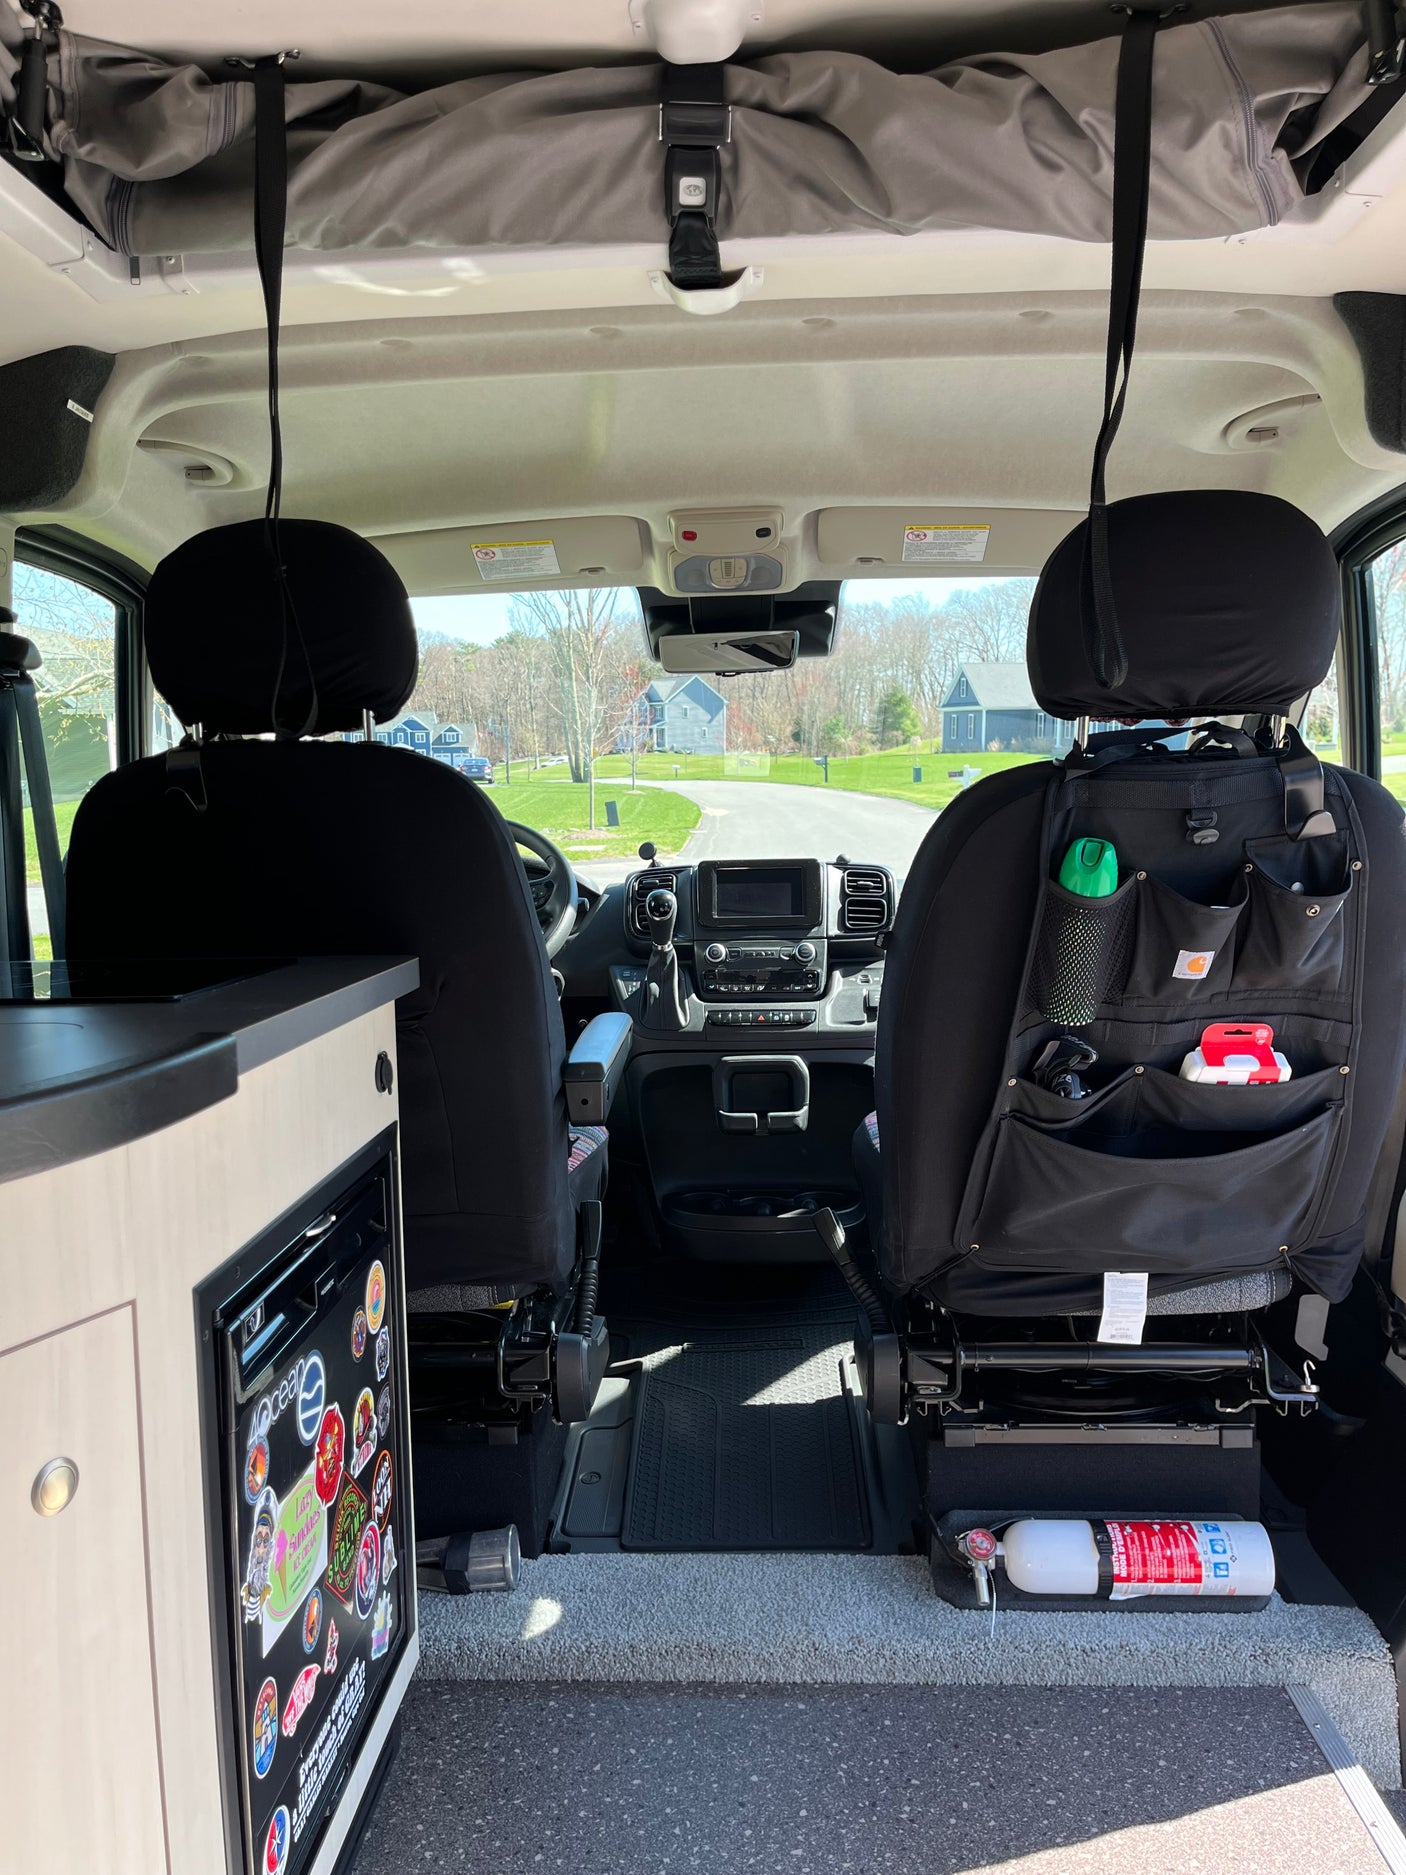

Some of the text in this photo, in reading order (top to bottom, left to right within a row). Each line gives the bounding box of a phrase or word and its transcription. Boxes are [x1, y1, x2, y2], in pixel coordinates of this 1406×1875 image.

[295, 1488, 313, 1522] Lazy
[289, 1510, 320, 1560] Sundaes
[1119, 1554, 1127, 1577] MODE
[300, 1715, 331, 1788] Everyone
[332, 1674, 348, 1720] could
[298, 1765, 318, 1813] little
[318, 1725, 337, 1770] touch
[337, 1705, 345, 1730] of
